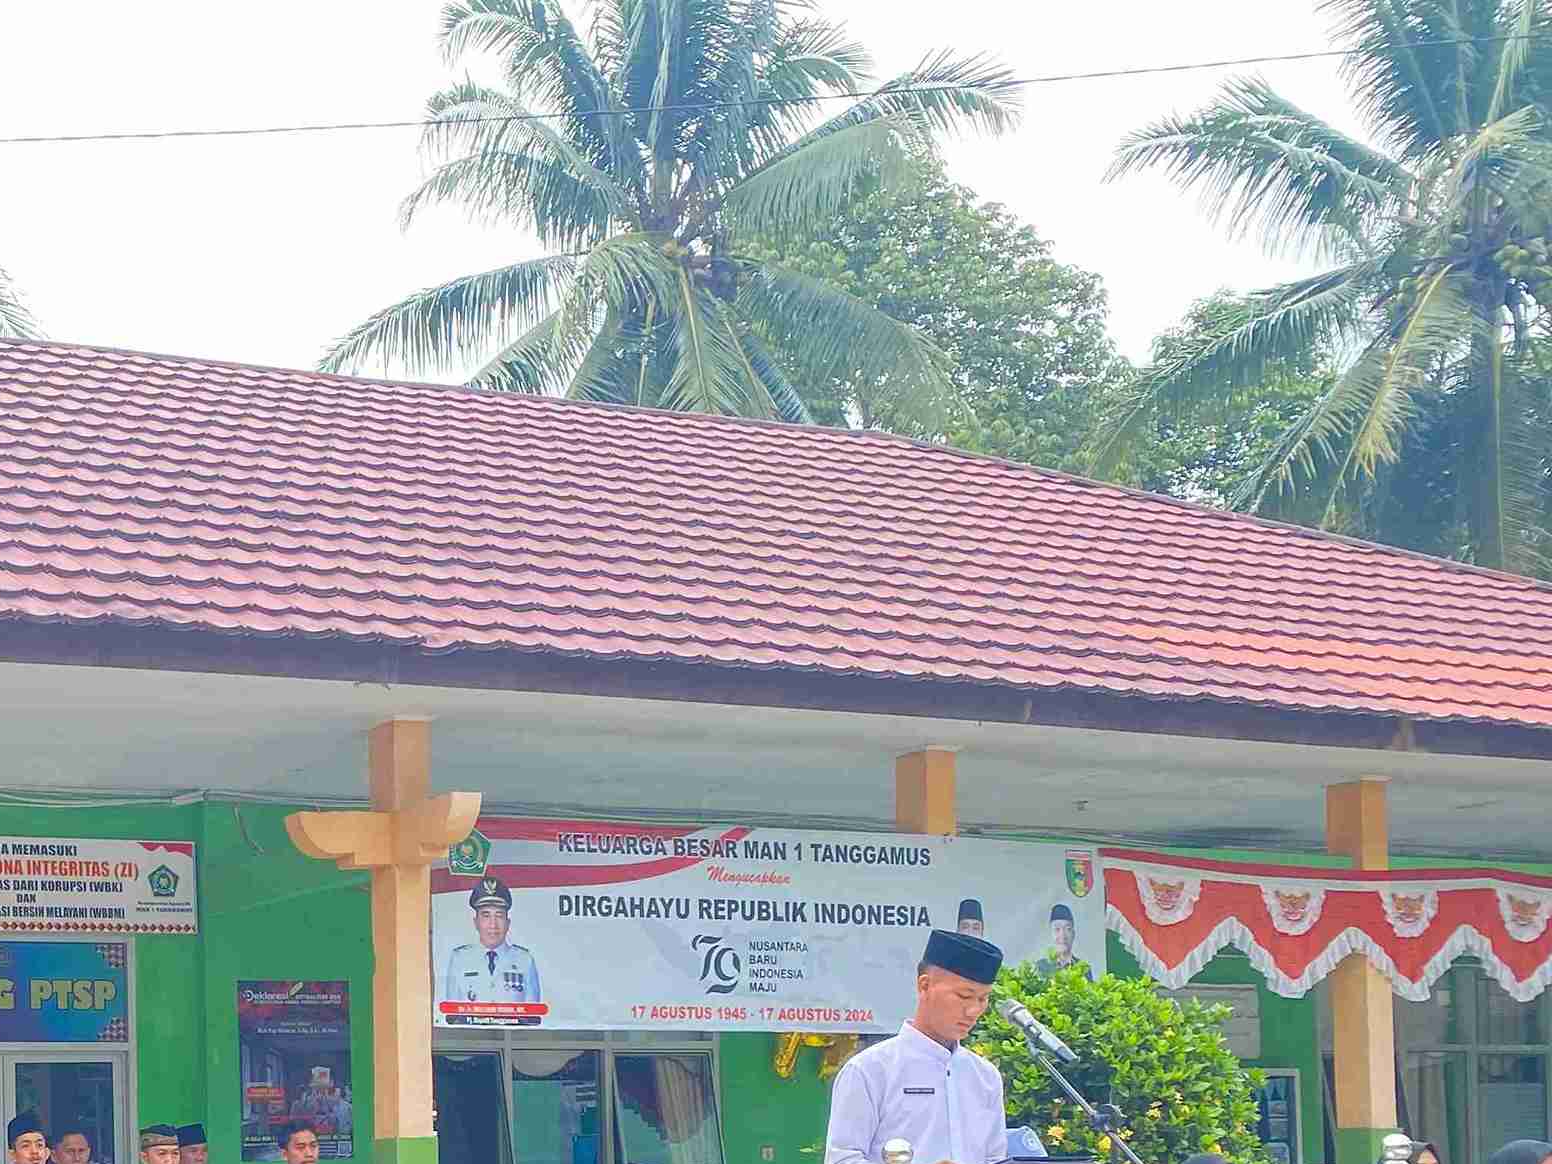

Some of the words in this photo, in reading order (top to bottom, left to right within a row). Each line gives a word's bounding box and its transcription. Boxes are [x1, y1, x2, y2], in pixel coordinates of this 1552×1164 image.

[11, 843, 77, 856] MEMASUKI
[557, 833, 668, 856] KELUARGA
[672, 837, 738, 859] BESAR
[744, 840, 788, 861] MAN
[793, 842, 802, 862] 1
[810, 843, 931, 867] TANGGAMUS
[28, 859, 110, 877] INTEGRITAS
[114, 861, 140, 880] (ZI)
[13, 880, 38, 891] DARI
[41, 880, 87, 892] KORUPSI
[16, 893, 37, 904] DAN
[12, 906, 44, 918] BERSIH
[46, 906, 88, 919] MELAYANI
[558, 894, 690, 920] DIRGAHAYU
[698, 898, 807, 924] REPUBLIK
[814, 903, 931, 928] INDONESIA
[748, 940, 809, 952] NUSANTARA
[748, 954, 777, 965] BARU
[748, 968, 804, 979] INDONESIA
[30, 977, 117, 1010] PTSP
[748, 982, 777, 993] MAJU
[631, 1005, 644, 1019] 17
[651, 1006, 712, 1020] AGUSTUS
[718, 1006, 747, 1020] 1945
[759, 1007, 774, 1020] 17
[778, 1008, 841, 1022] AGUSTUS
[845, 1009, 874, 1023] 2024
